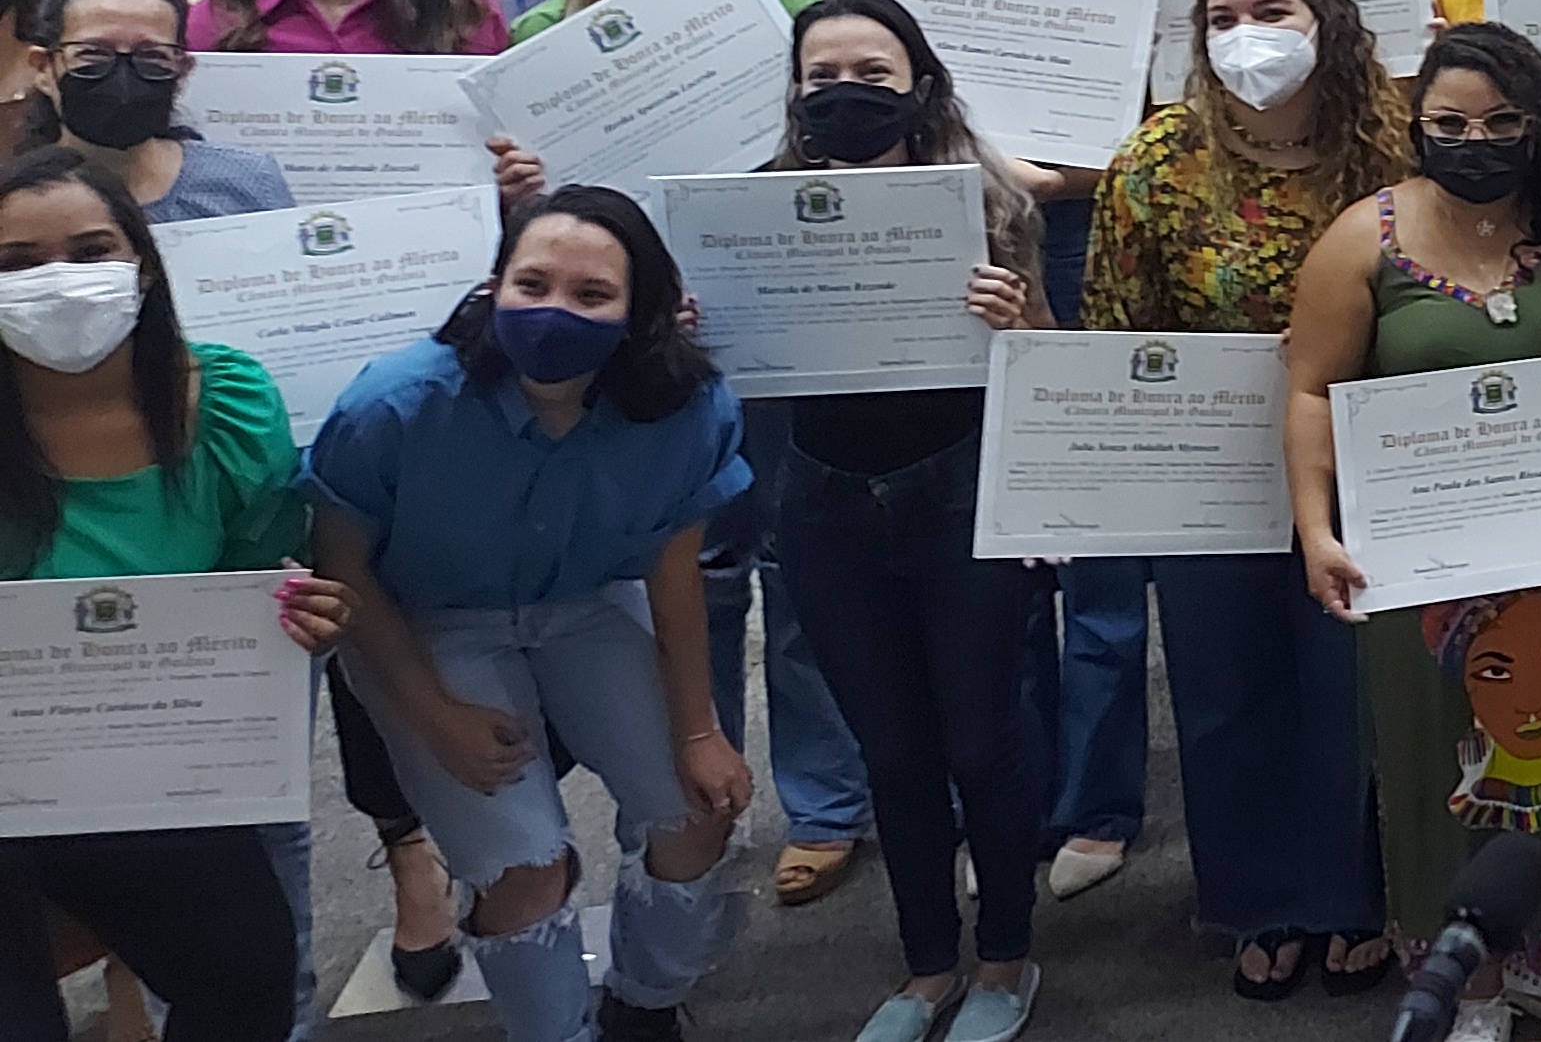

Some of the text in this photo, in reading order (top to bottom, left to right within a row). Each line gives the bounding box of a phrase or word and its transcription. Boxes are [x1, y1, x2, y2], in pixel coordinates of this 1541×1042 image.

[1043, 6, 1061, 18] ao
[526, 78, 594, 117] Diploma
[205, 108, 281, 125] Diploma
[285, 110, 304, 124] de
[311, 108, 367, 124] Honra
[372, 113, 392, 125] ao
[699, 233, 773, 250] Diploma
[776, 232, 795, 246] de
[800, 229, 856, 245] Honra
[860, 230, 879, 243] ao
[195, 272, 277, 294] Diploma
[280, 269, 301, 283] de
[306, 261, 367, 279] Honra
[372, 258, 393, 272] ao
[1031, 386, 1103, 405] Diploma
[1107, 389, 1126, 403] de
[1130, 388, 1183, 404] Honra
[1186, 392, 1206, 404] ao
[1379, 429, 1450, 448] Diploma
[1453, 426, 1471, 439] de
[1475, 419, 1528, 437] Honra
